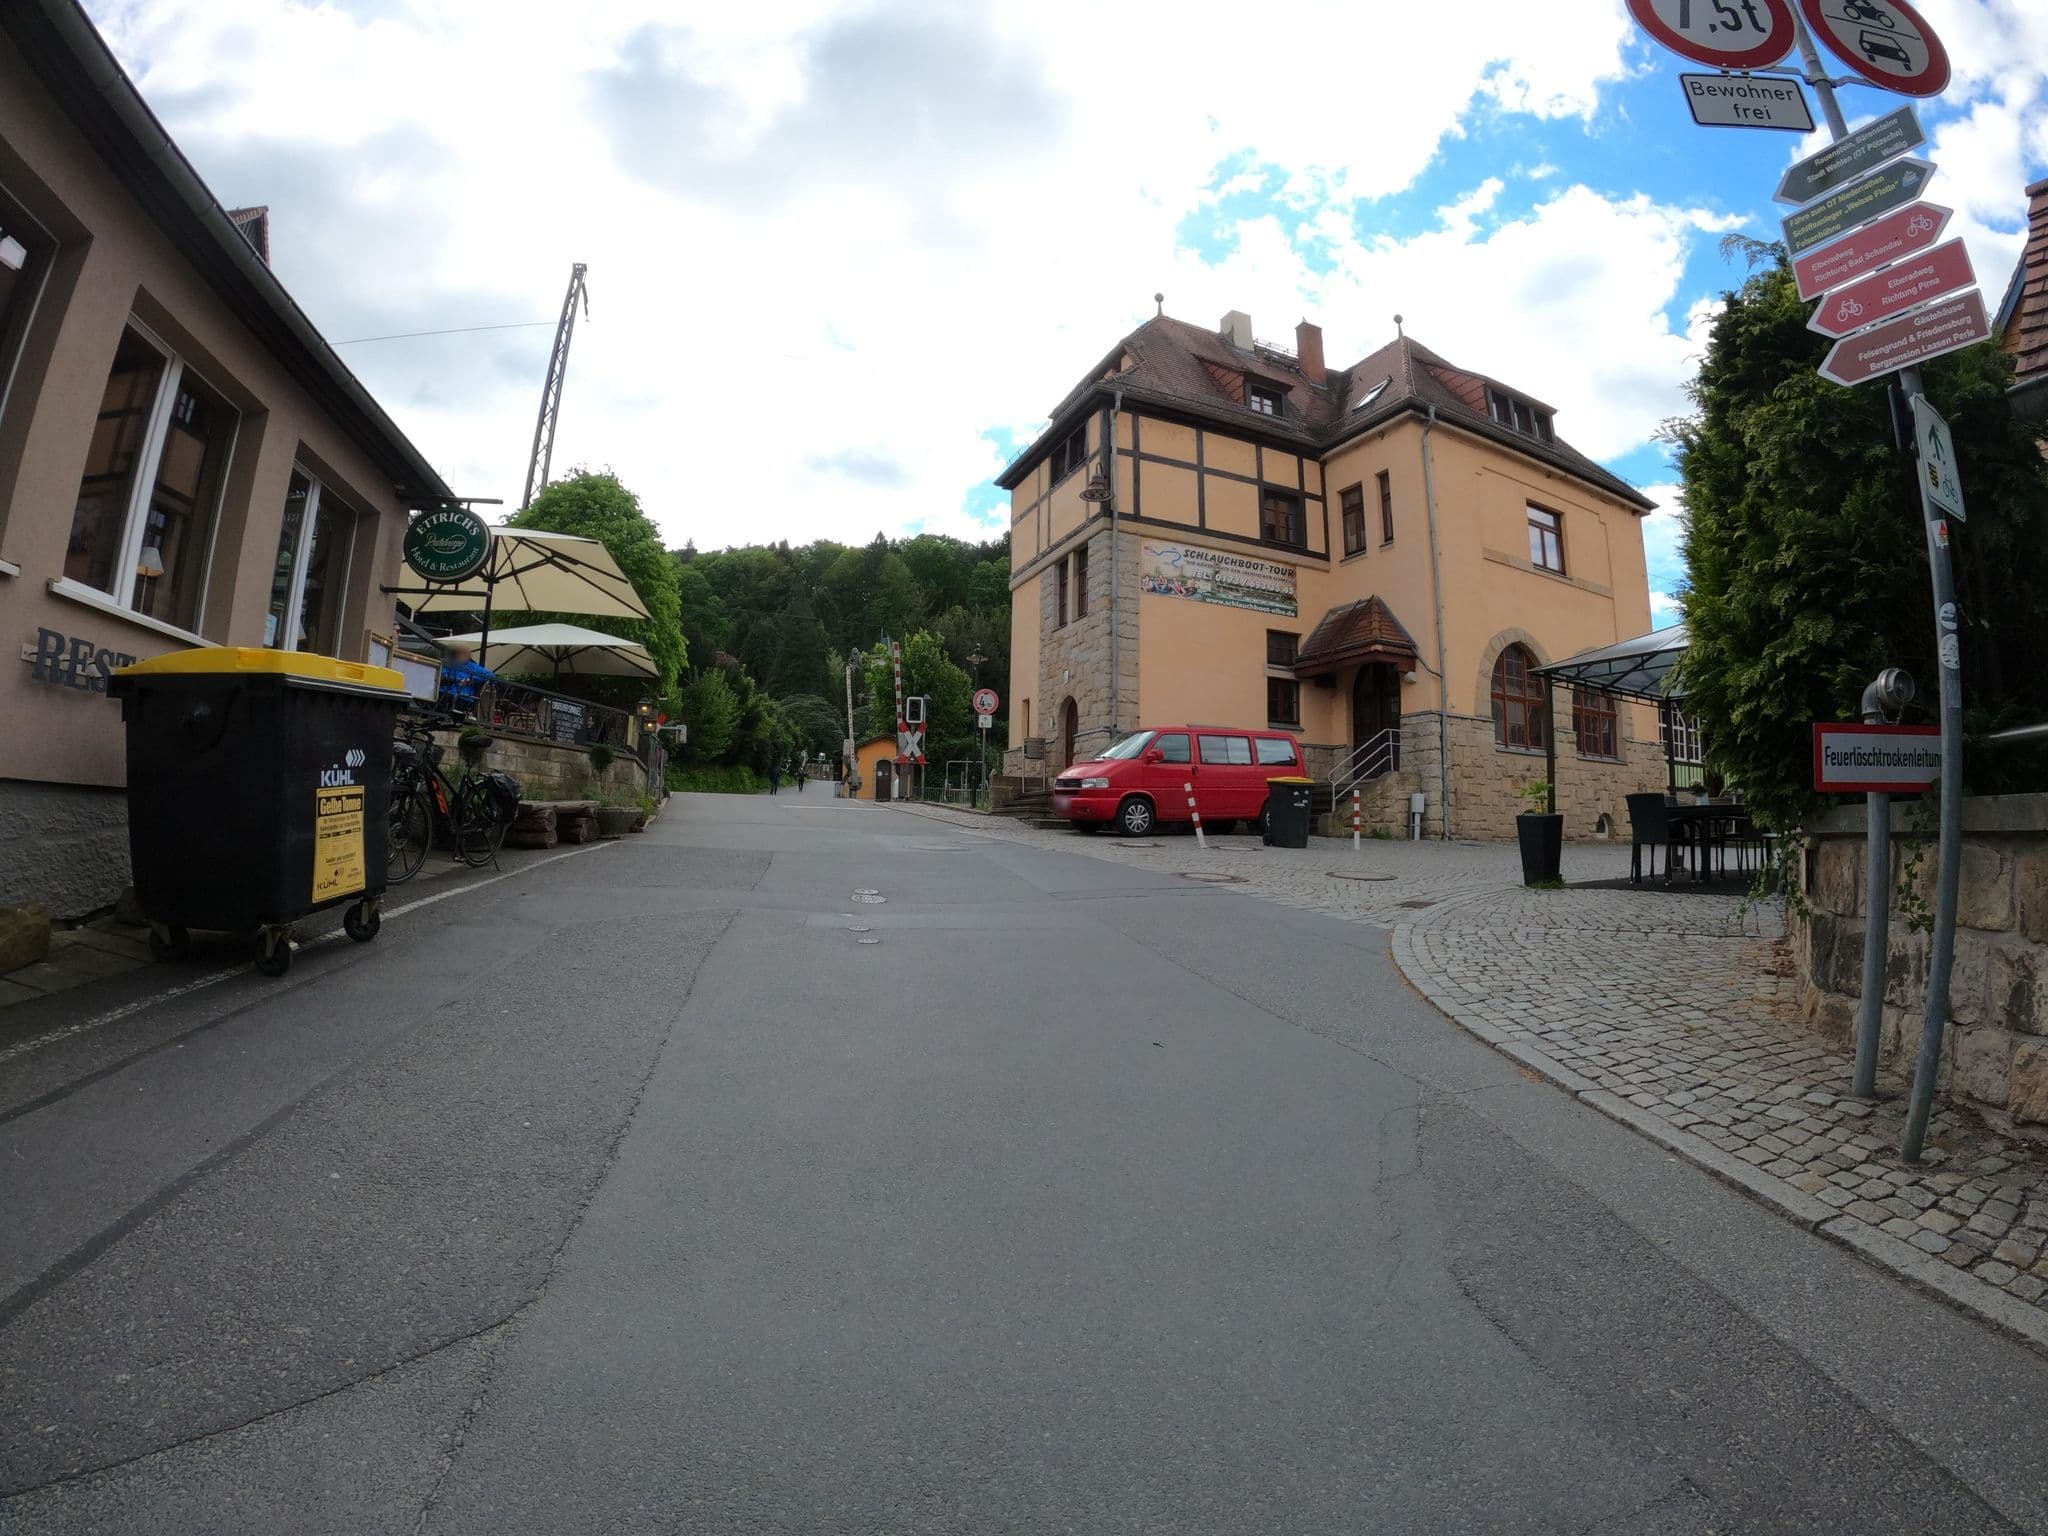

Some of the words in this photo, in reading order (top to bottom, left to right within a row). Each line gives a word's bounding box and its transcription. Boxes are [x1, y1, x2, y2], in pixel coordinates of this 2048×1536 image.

[1689, 81, 1794, 102] Bewohner
[1733, 104, 1771, 121] frei
[1806, 169, 1826, 183] Stadt
[1826, 155, 1852, 173] Wehlen
[1853, 146, 1868, 161] (OT
[1790, 212, 1810, 227] Fähre
[1810, 206, 1826, 218] zum
[1827, 198, 1838, 208] OT
[1796, 224, 1841, 249] Felsenbühne
[1811, 247, 1854, 272] Elberadweg
[1814, 262, 1849, 284] Richtung
[1848, 254, 1865, 268] Bad
[1864, 239, 1903, 260] Schandau
[1887, 264, 1934, 290] Elberadweg
[1881, 284, 1919, 307] Richtung
[1918, 276, 1941, 291] Pirna
[1913, 302, 1966, 326] Gästehäuser
[1857, 336, 1908, 363] Felsengrund
[1907, 333, 1917, 344] &
[1915, 315, 1972, 341] Friedensburg
[1869, 348, 1921, 373] Bergpension
[1921, 337, 1952, 354] Laasen
[1952, 329, 1976, 344] Perle
[415, 512, 480, 535] ETTRICH'S
[410, 546, 430, 567] Hotel
[429, 563, 438, 571] &
[439, 546, 480, 571] Restaurant
[1183, 549, 1296, 578] SCHLAUCHBOOT-TOUR
[1824, 745, 1941, 769] Feuerlöschtrockenleitun
[320, 764, 355, 787] KÜHL
[320, 798, 343, 815] Gelbe
[317, 877, 338, 891] KÜHL
